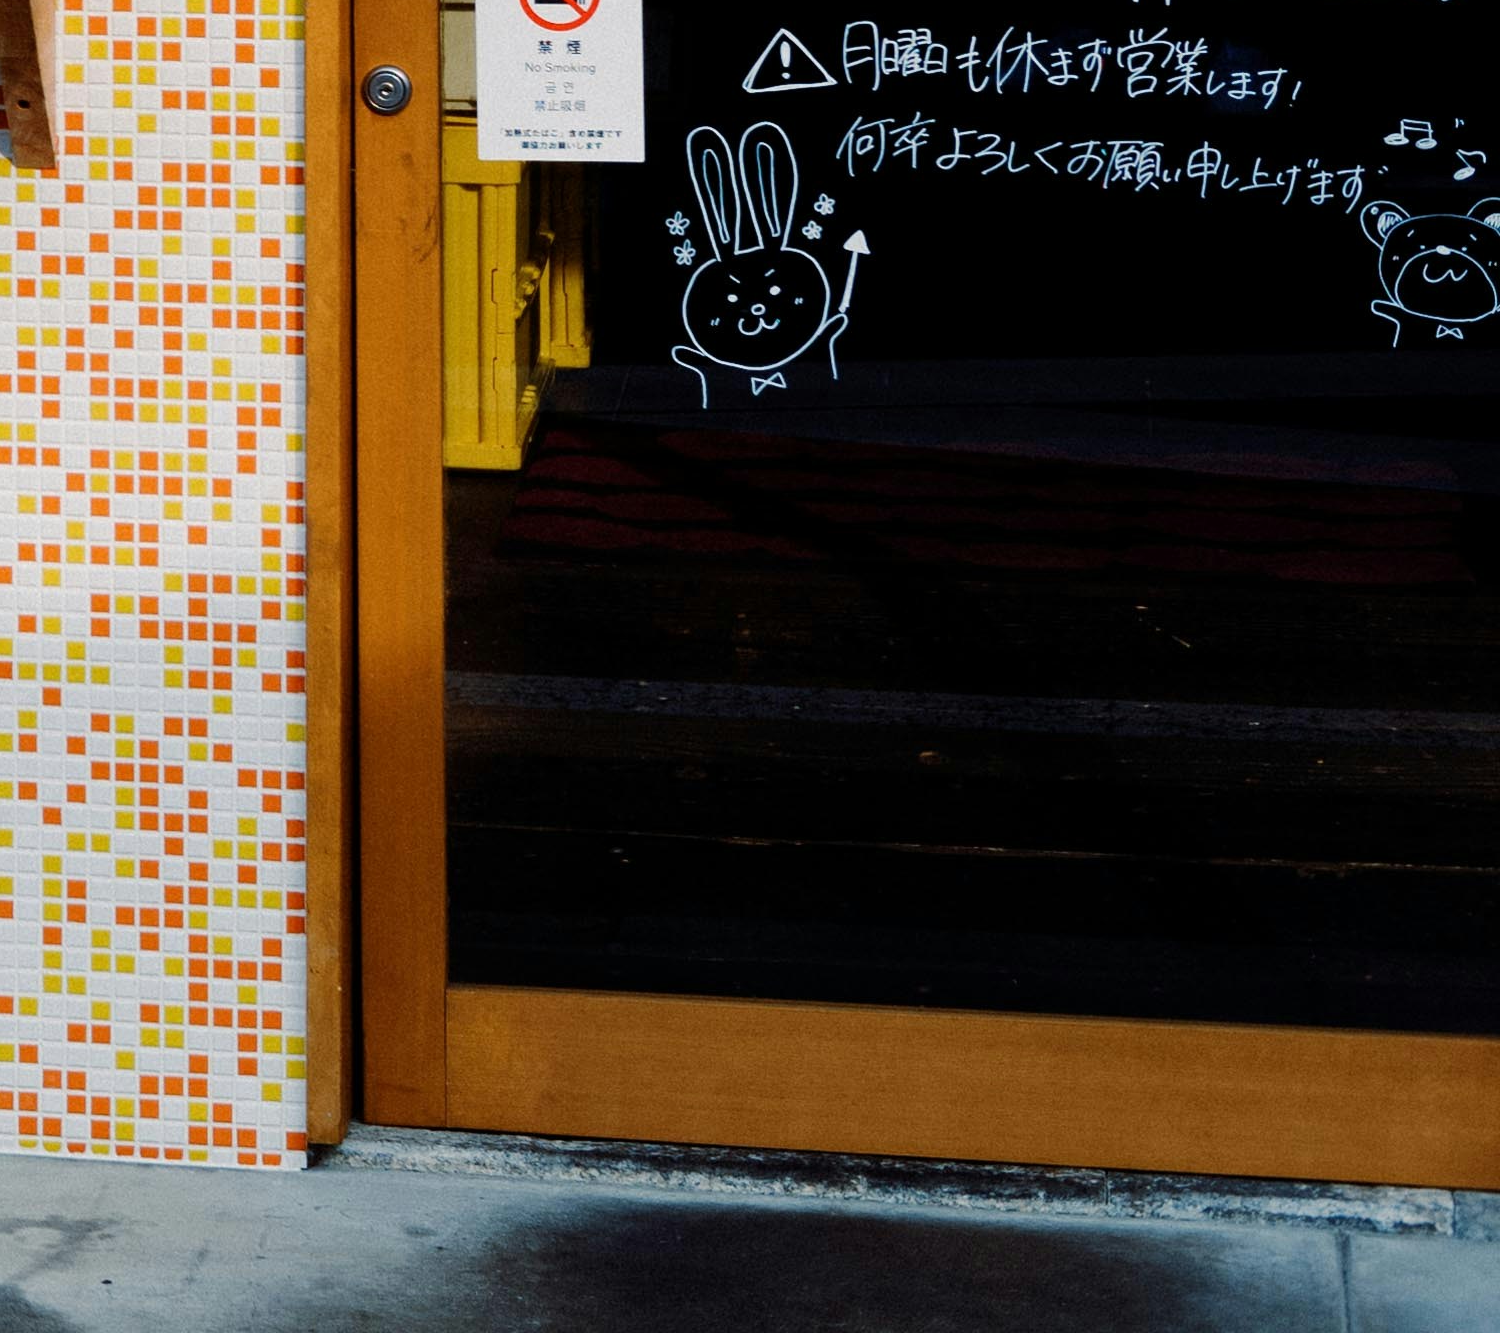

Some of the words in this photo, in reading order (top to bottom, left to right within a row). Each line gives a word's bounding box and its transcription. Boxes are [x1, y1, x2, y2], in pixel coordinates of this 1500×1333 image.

[538, 40, 581, 55] 禁煙
[525, 62, 542, 73] No
[545, 62, 596, 76] Smoking
